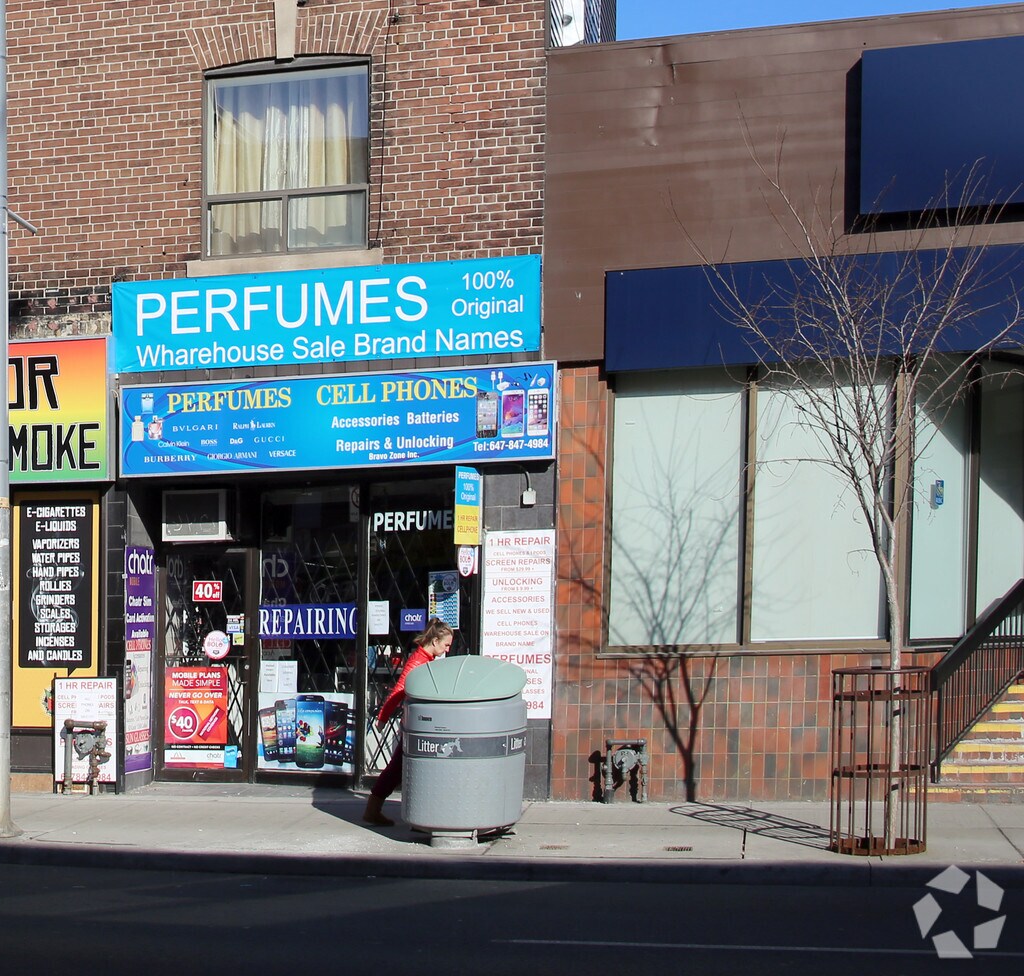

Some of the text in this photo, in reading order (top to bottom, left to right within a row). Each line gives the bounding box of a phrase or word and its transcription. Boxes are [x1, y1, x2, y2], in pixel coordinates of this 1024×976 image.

[462, 270, 514, 291] 100%
[136, 276, 428, 337] PERFUMES
[451, 295, 524, 319] Original
[136, 328, 524, 367] Wharehouse Sale Brand Names
[167, 376, 478, 414] PERFUMES CELL PHONES
[331, 411, 459, 429] Accessories Batteries
[172, 424, 218, 432] BVLGARI
[158, 440, 175, 448] Calvin
[175, 440, 189, 448] Klein
[230, 437, 243, 445] D&G
[254, 435, 285, 444] GUCCI
[336, 435, 454, 454] Repairs & Unlocking
[144, 449, 296, 463] BURBERRY GIORGIO ARMANI VERSACE
[368, 451, 419, 461] Bravo Zone Inc.
[458, 471, 480, 481] PERFUMES
[463, 483, 474, 492] 100%
[460, 492, 477, 503] Original
[26, 506, 86, 518] E-CIGARETTES
[465, 514, 478, 522] REPAIR
[35, 520, 77, 532] E-LIQUIDS
[32, 538, 80, 550] VAPORIZERS
[489, 536, 551, 546] 1 HR REPAIR
[32, 552, 80, 564] WATER PIPES
[128, 549, 153, 574] chatr
[485, 559, 516, 567] SCREEN
[32, 566, 79, 578] HAND PIPES
[39, 580, 72, 592] ROLLIES
[492, 577, 543, 586] UNLOCKING
[36, 594, 75, 605] GRINDERS
[128, 595, 152, 607] Chatr Sim
[491, 595, 545, 603] ACCESSORIES
[40, 608, 71, 619] SCALES
[126, 612, 136, 624] Card
[405, 613, 422, 622] chatr
[34, 622, 76, 633] STORAGES
[35, 636, 75, 647] INCENSES
[28, 650, 83, 661] AND CANDLES
[484, 654, 551, 664] RFUMES
[81, 681, 113, 690] REPAIR
[172, 679, 221, 687] MADE SIMPLE
[417, 737, 523, 753] Litter Litter
